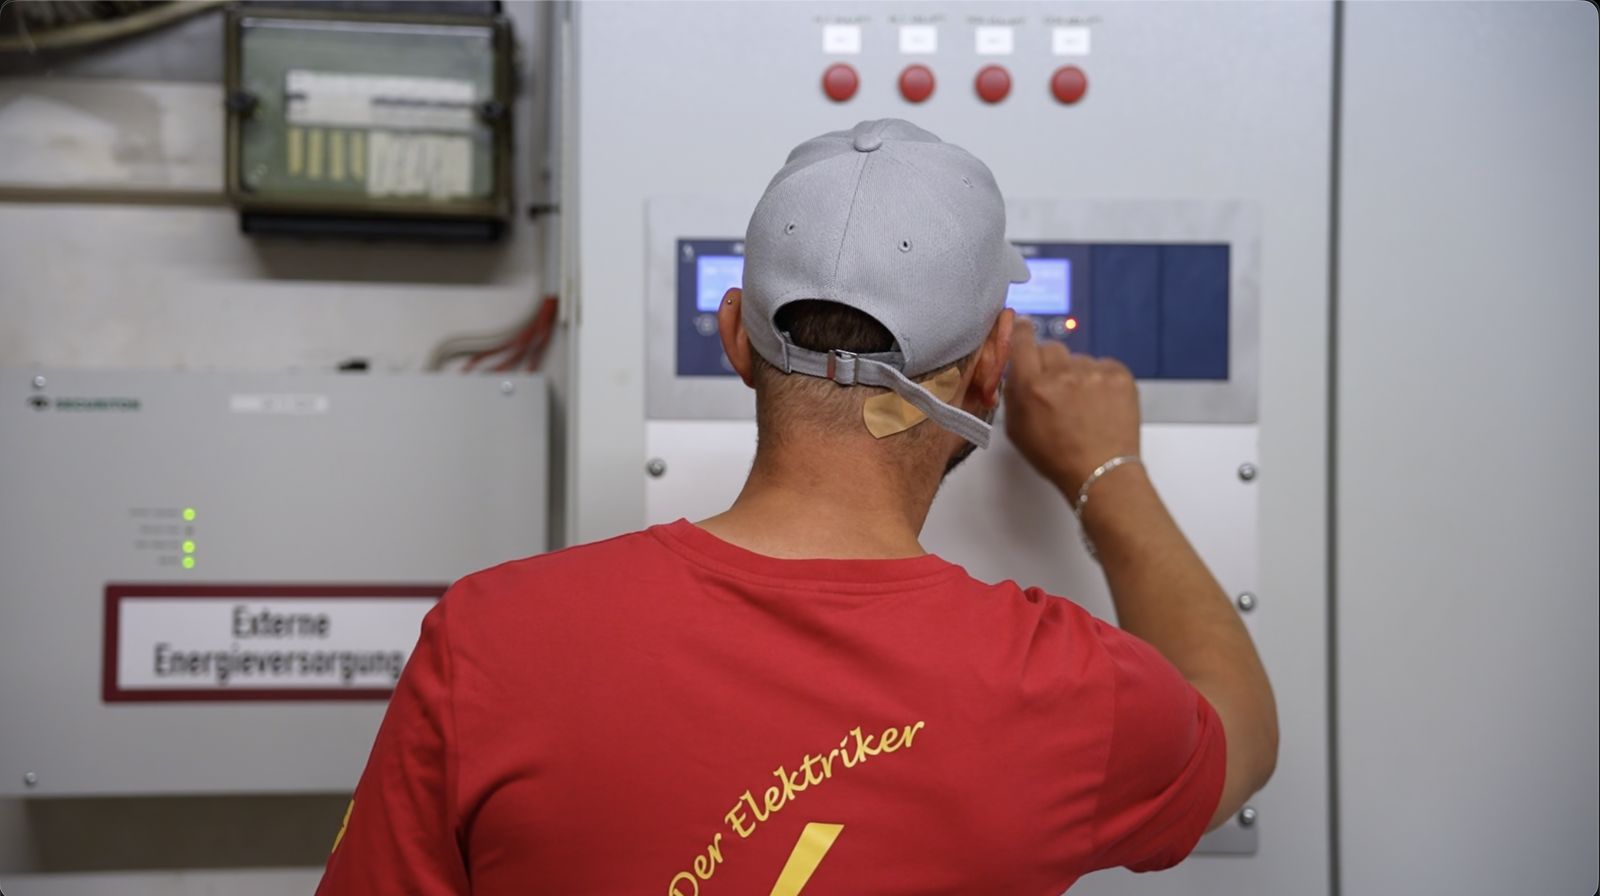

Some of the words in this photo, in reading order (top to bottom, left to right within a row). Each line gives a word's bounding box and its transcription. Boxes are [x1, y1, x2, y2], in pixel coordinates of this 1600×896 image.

[232, 606, 330, 638] Externe
[153, 641, 403, 684] Energieversorgung
[724, 720, 925, 838] Elektriker
